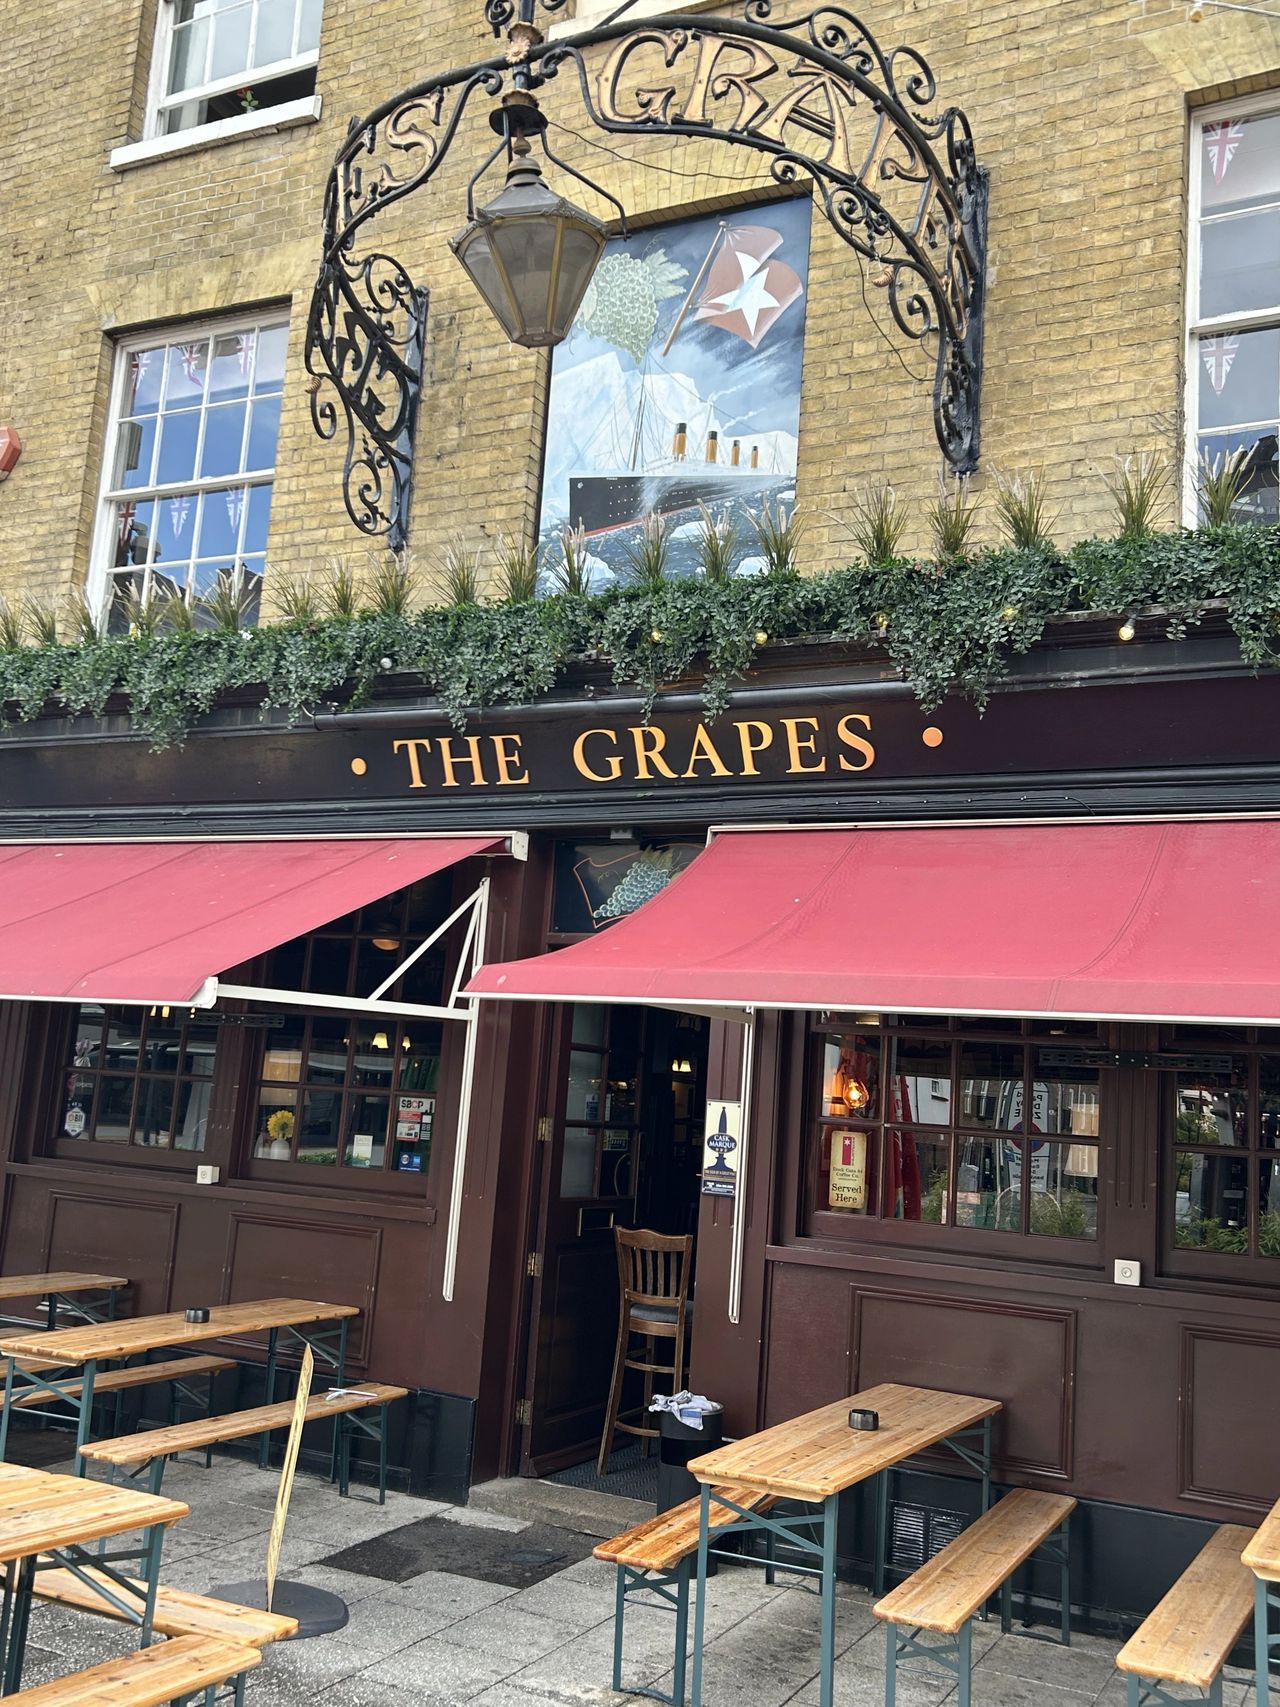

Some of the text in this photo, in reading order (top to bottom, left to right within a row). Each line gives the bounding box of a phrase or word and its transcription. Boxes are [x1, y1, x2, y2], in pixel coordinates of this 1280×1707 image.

[392, 713, 876, 789] THE GRAPES
[713, 1134, 730, 1142] CASK
[708, 1140, 736, 1149] MARQUE
[831, 1183, 862, 1194] Served
[835, 1193, 858, 1204] Here
